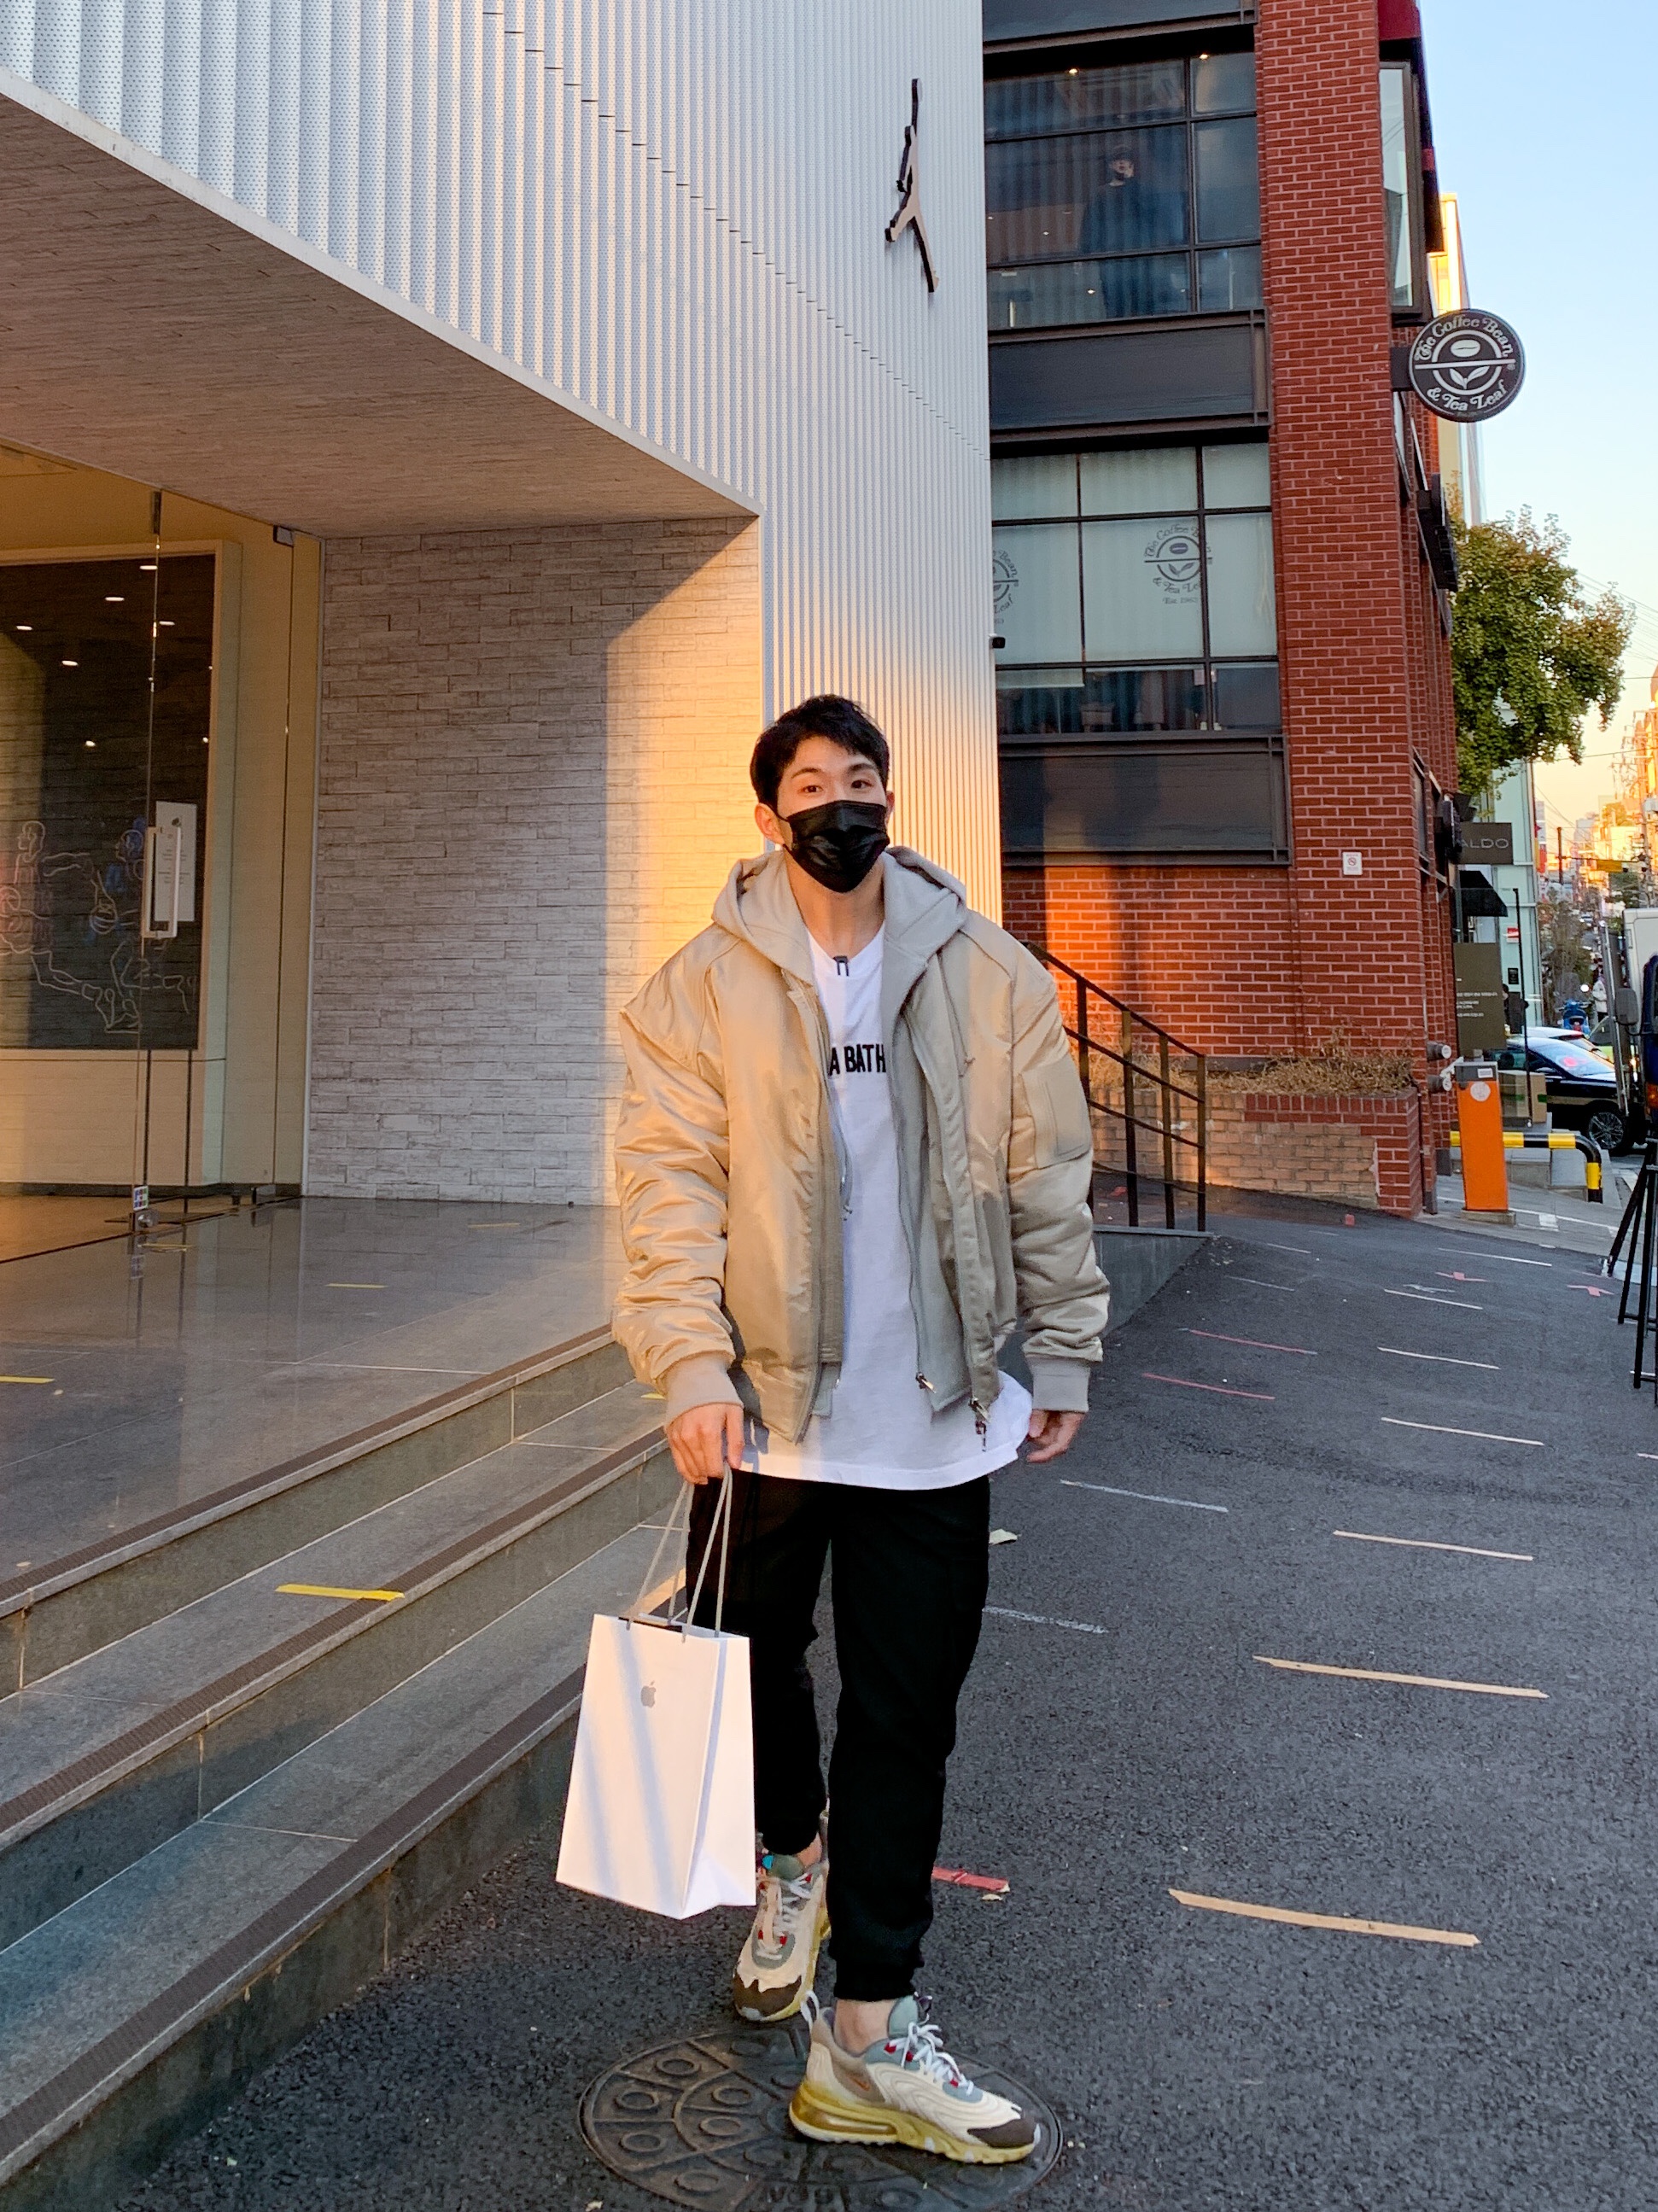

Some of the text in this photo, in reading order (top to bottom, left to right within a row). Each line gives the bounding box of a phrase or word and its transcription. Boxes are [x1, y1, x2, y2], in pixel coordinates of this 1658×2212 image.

[1415, 315, 1514, 362] The Coffee Bean
[1426, 378, 1509, 411] & Tea Leaf
[844, 1043, 887, 1073] BATH
